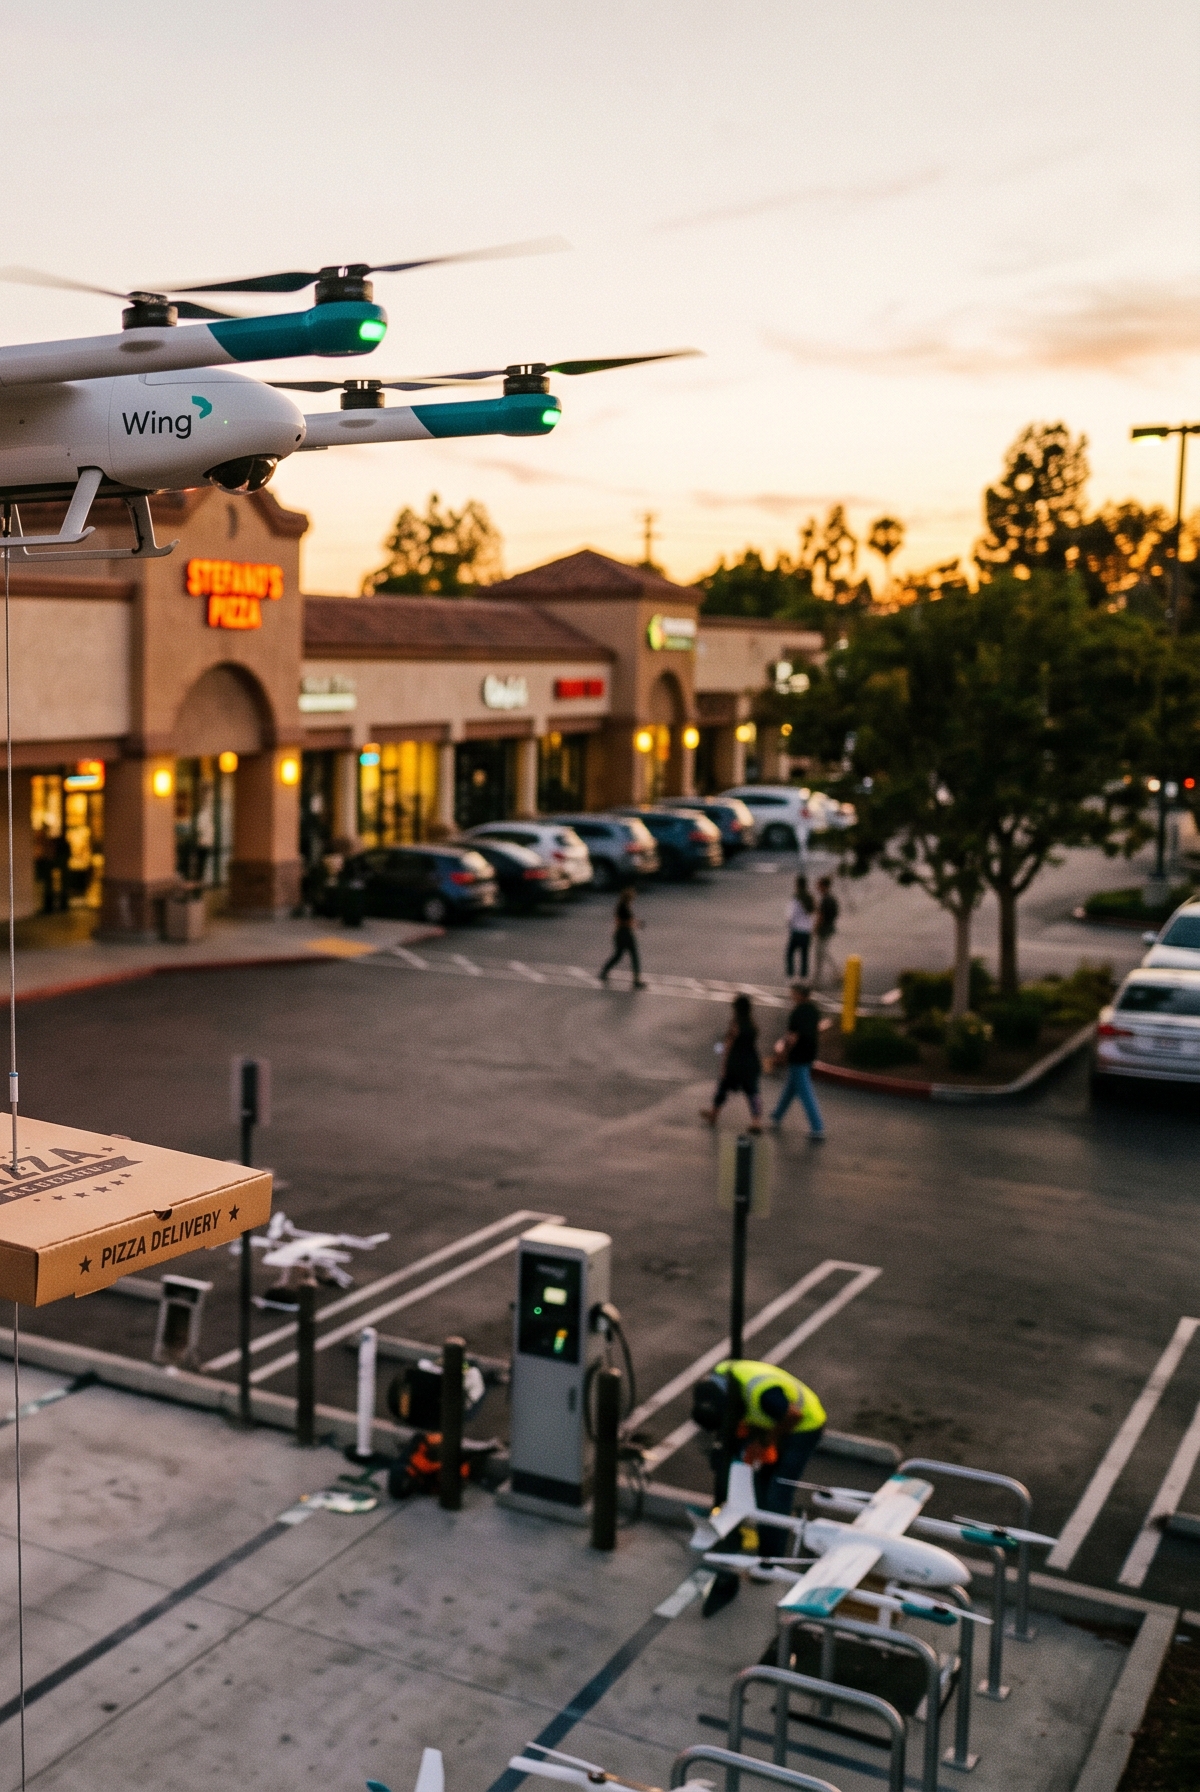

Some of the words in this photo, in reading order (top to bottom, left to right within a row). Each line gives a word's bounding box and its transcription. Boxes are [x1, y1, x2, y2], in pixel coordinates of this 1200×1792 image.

[122, 410, 191, 439] Wing
[101, 1236, 146, 1269] PIZZA
[151, 1208, 222, 1252] DELIVERY
